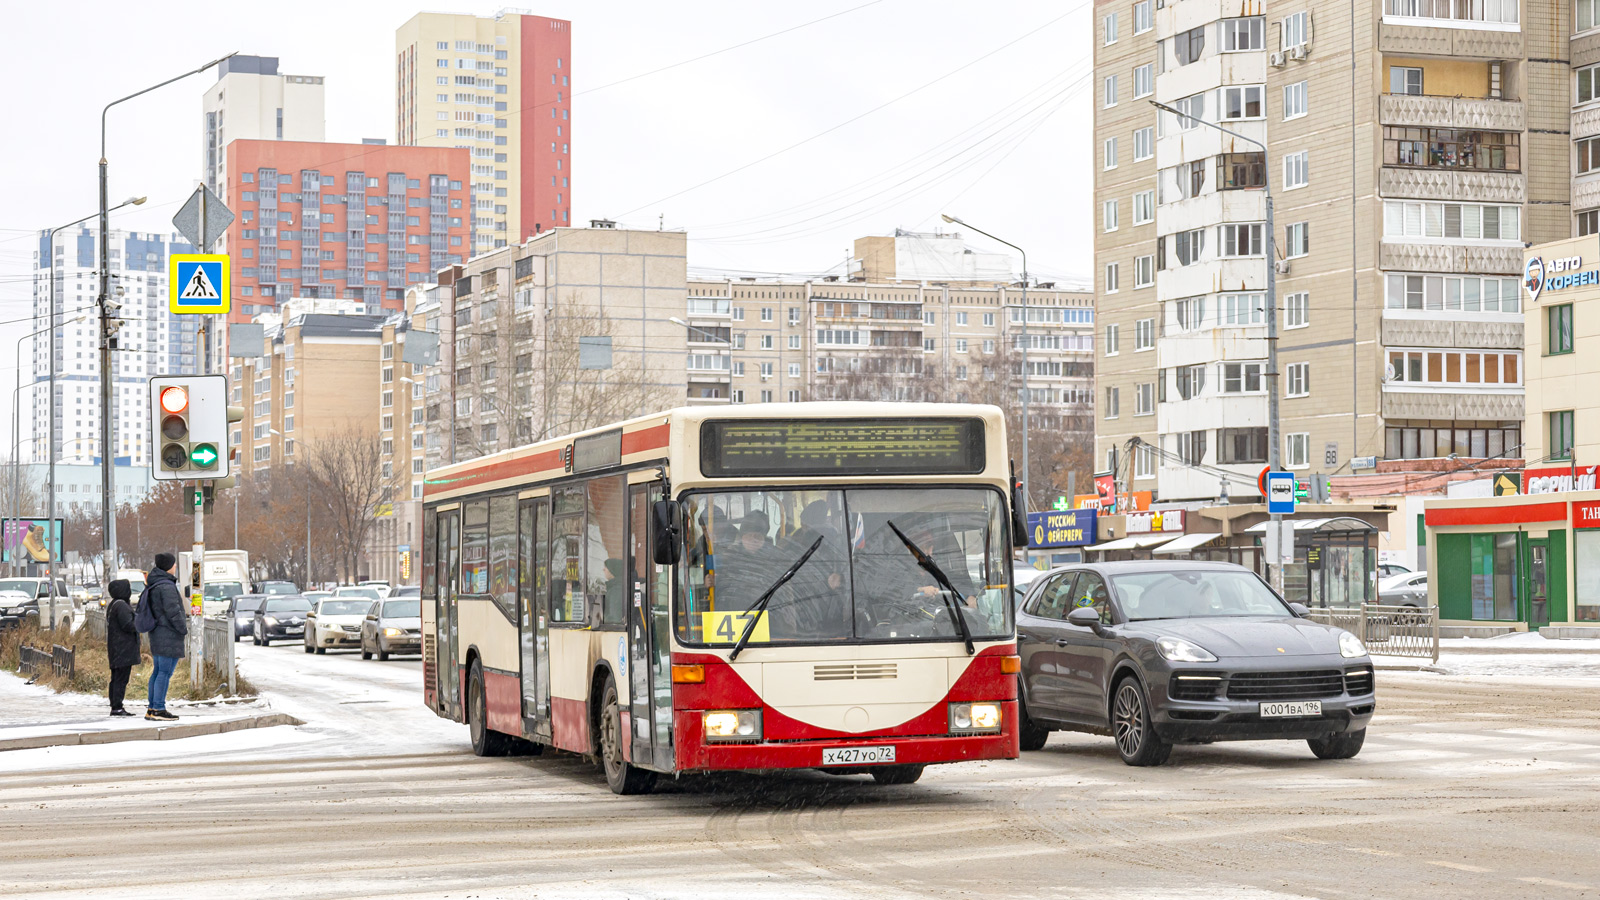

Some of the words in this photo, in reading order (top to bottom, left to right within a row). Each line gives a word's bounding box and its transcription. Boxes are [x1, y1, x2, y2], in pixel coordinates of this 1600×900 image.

[1546, 256, 1581, 273] АВТО
[1545, 270, 1599, 291] КОРЕЕЦ
[1047, 512, 1076, 528] РУССКИЙ
[1047, 528, 1083, 544] ФЕЙЕРВЕРК
[716, 614, 755, 642] 47
[1263, 704, 1303, 715] К001ВА
[1304, 702, 1319, 711] 196
[827, 750, 877, 763] Х427УО
[879, 748, 891, 757] 72
